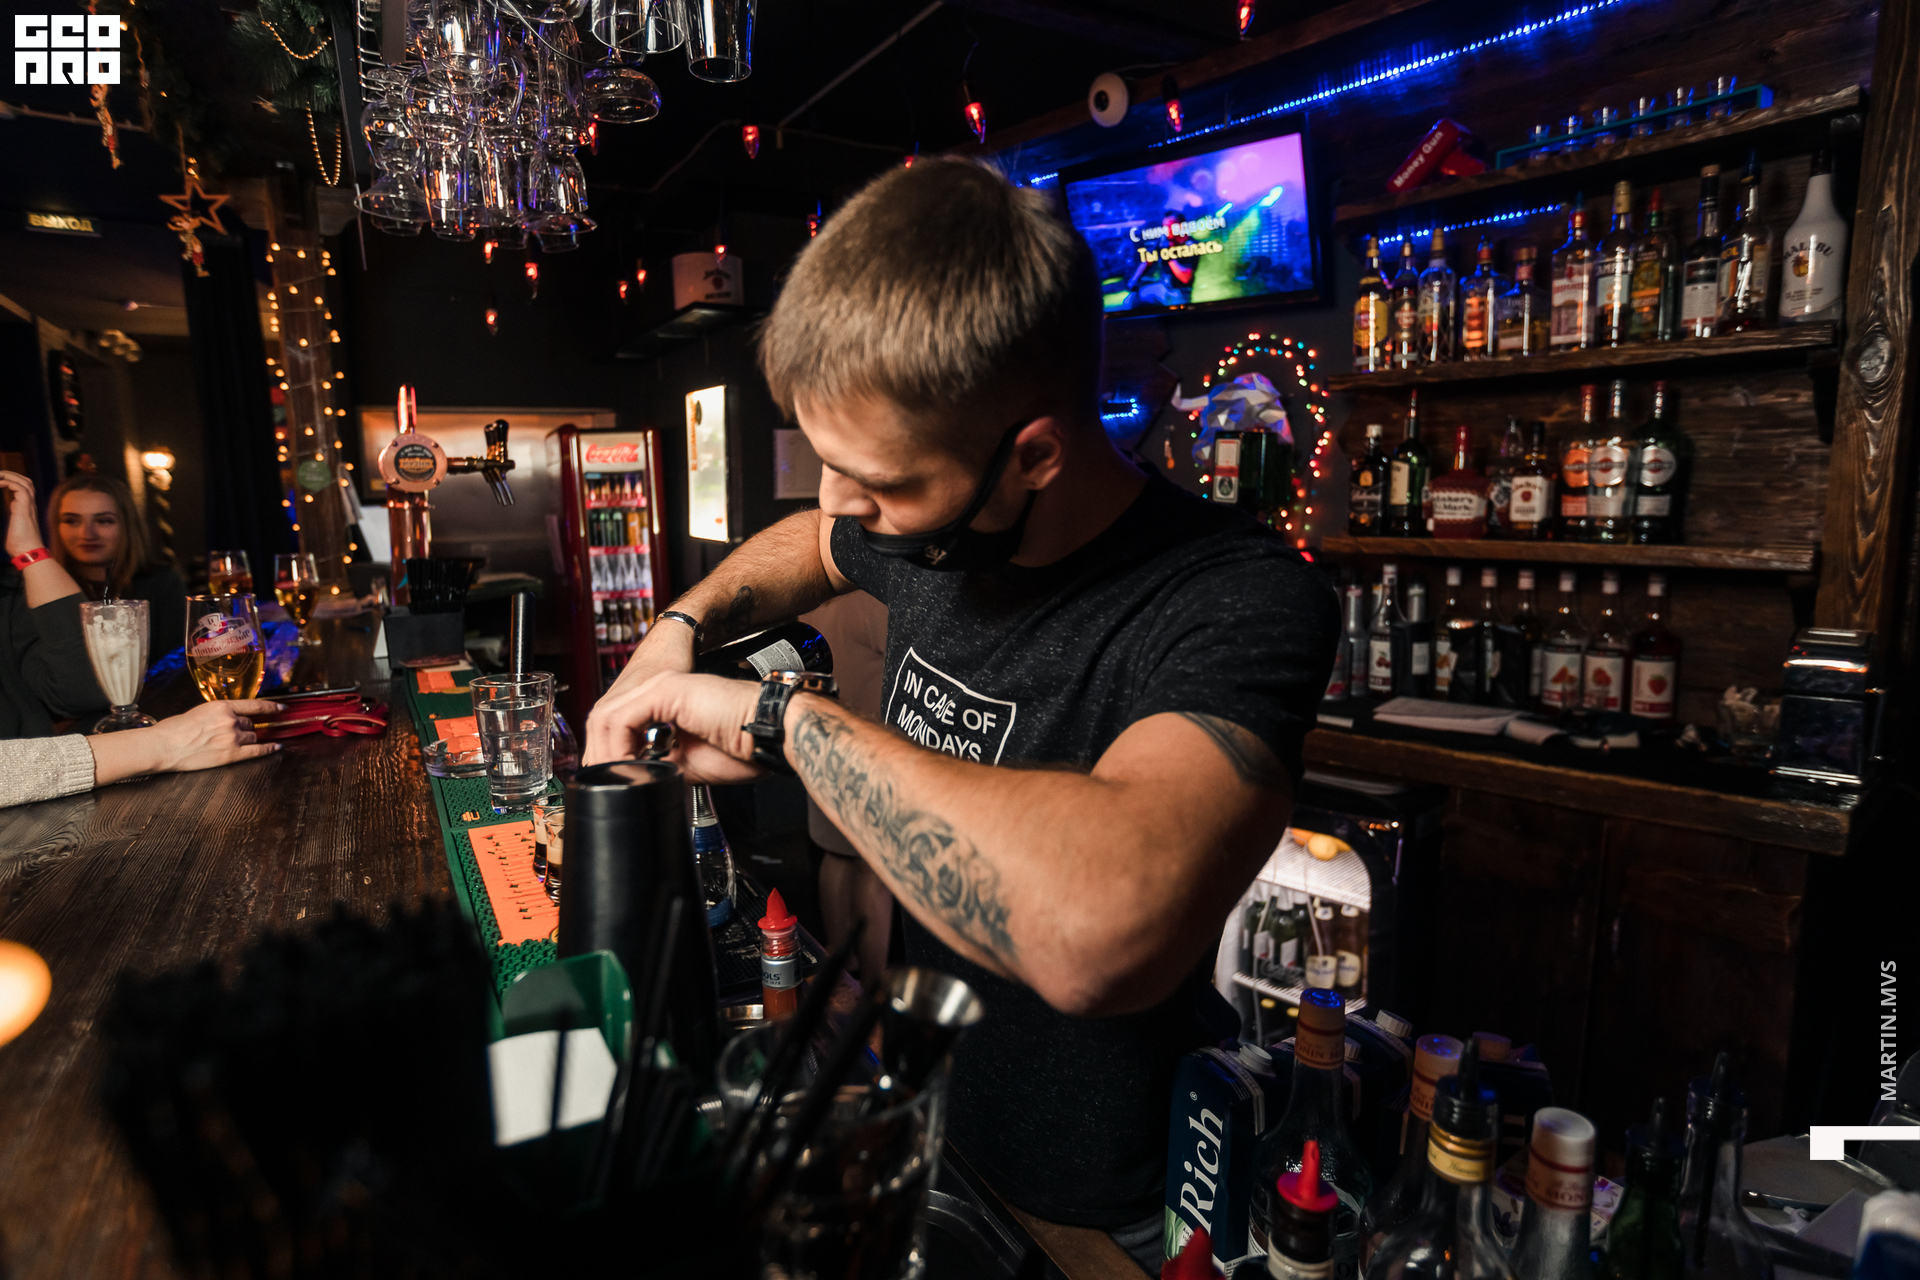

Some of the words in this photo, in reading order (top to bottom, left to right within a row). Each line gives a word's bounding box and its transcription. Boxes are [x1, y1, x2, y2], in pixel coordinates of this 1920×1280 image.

[1393, 153, 1426, 188] Money
[1422, 131, 1444, 154] Gun
[27, 212, 94, 233] ВЫХОД
[1129, 228, 1139, 243] С
[1142, 225, 1169, 240] ним
[1137, 246, 1158, 263] Ты
[1160, 240, 1224, 261] осталась
[903, 669, 923, 699] IN
[962, 708, 997, 734] OF
[897, 703, 982, 762] MONDAYS
[1296, 1042, 1325, 1060] ONIN
[1179, 1107, 1224, 1237] Rich
